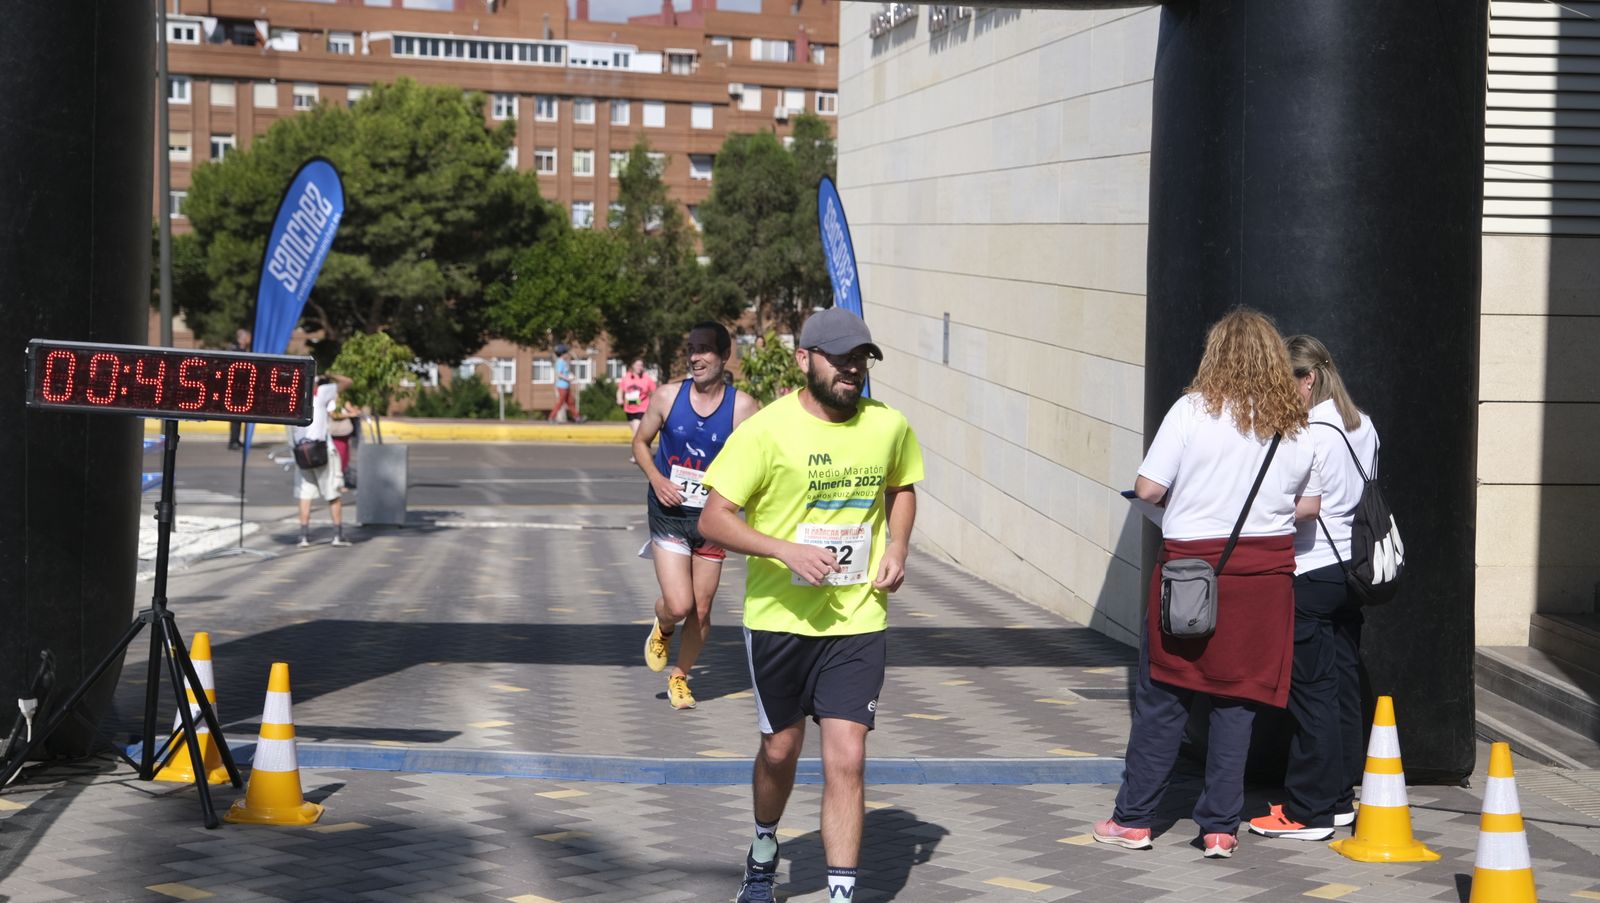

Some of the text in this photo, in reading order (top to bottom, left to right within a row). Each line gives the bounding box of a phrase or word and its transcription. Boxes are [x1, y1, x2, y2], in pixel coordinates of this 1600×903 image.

[808, 465, 884, 479] Medio Maratón
[680, 480, 710, 496] 175
[808, 475, 885, 491] Almería 2022
